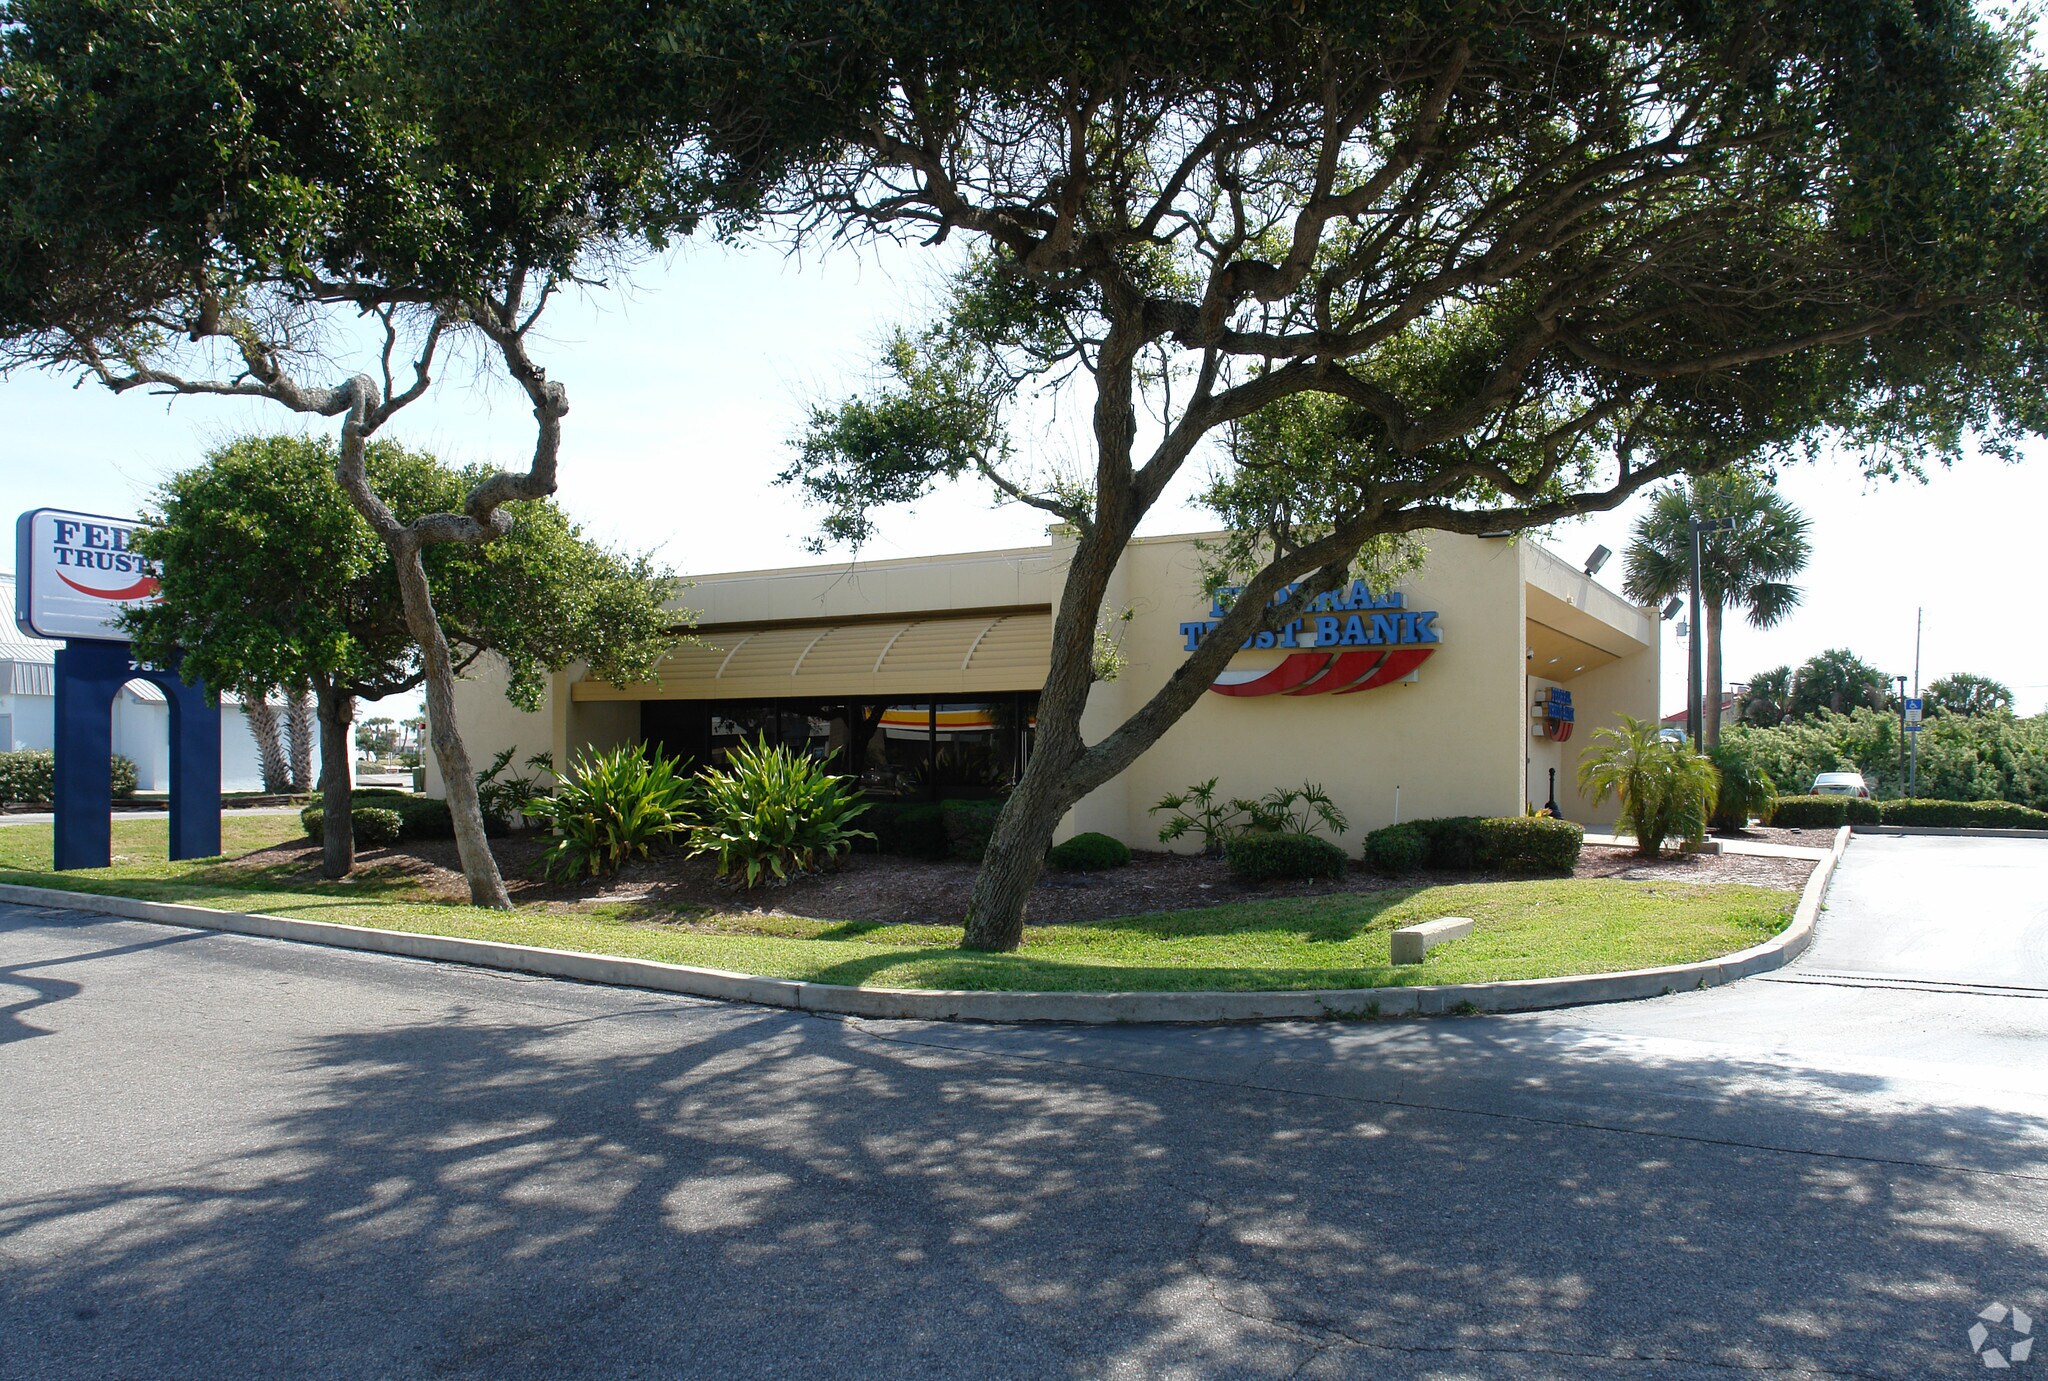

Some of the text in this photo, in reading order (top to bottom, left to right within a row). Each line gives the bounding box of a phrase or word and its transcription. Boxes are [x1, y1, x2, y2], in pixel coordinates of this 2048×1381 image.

[53, 546, 147, 574] TRUST
[1180, 611, 1439, 651] TST BANK
